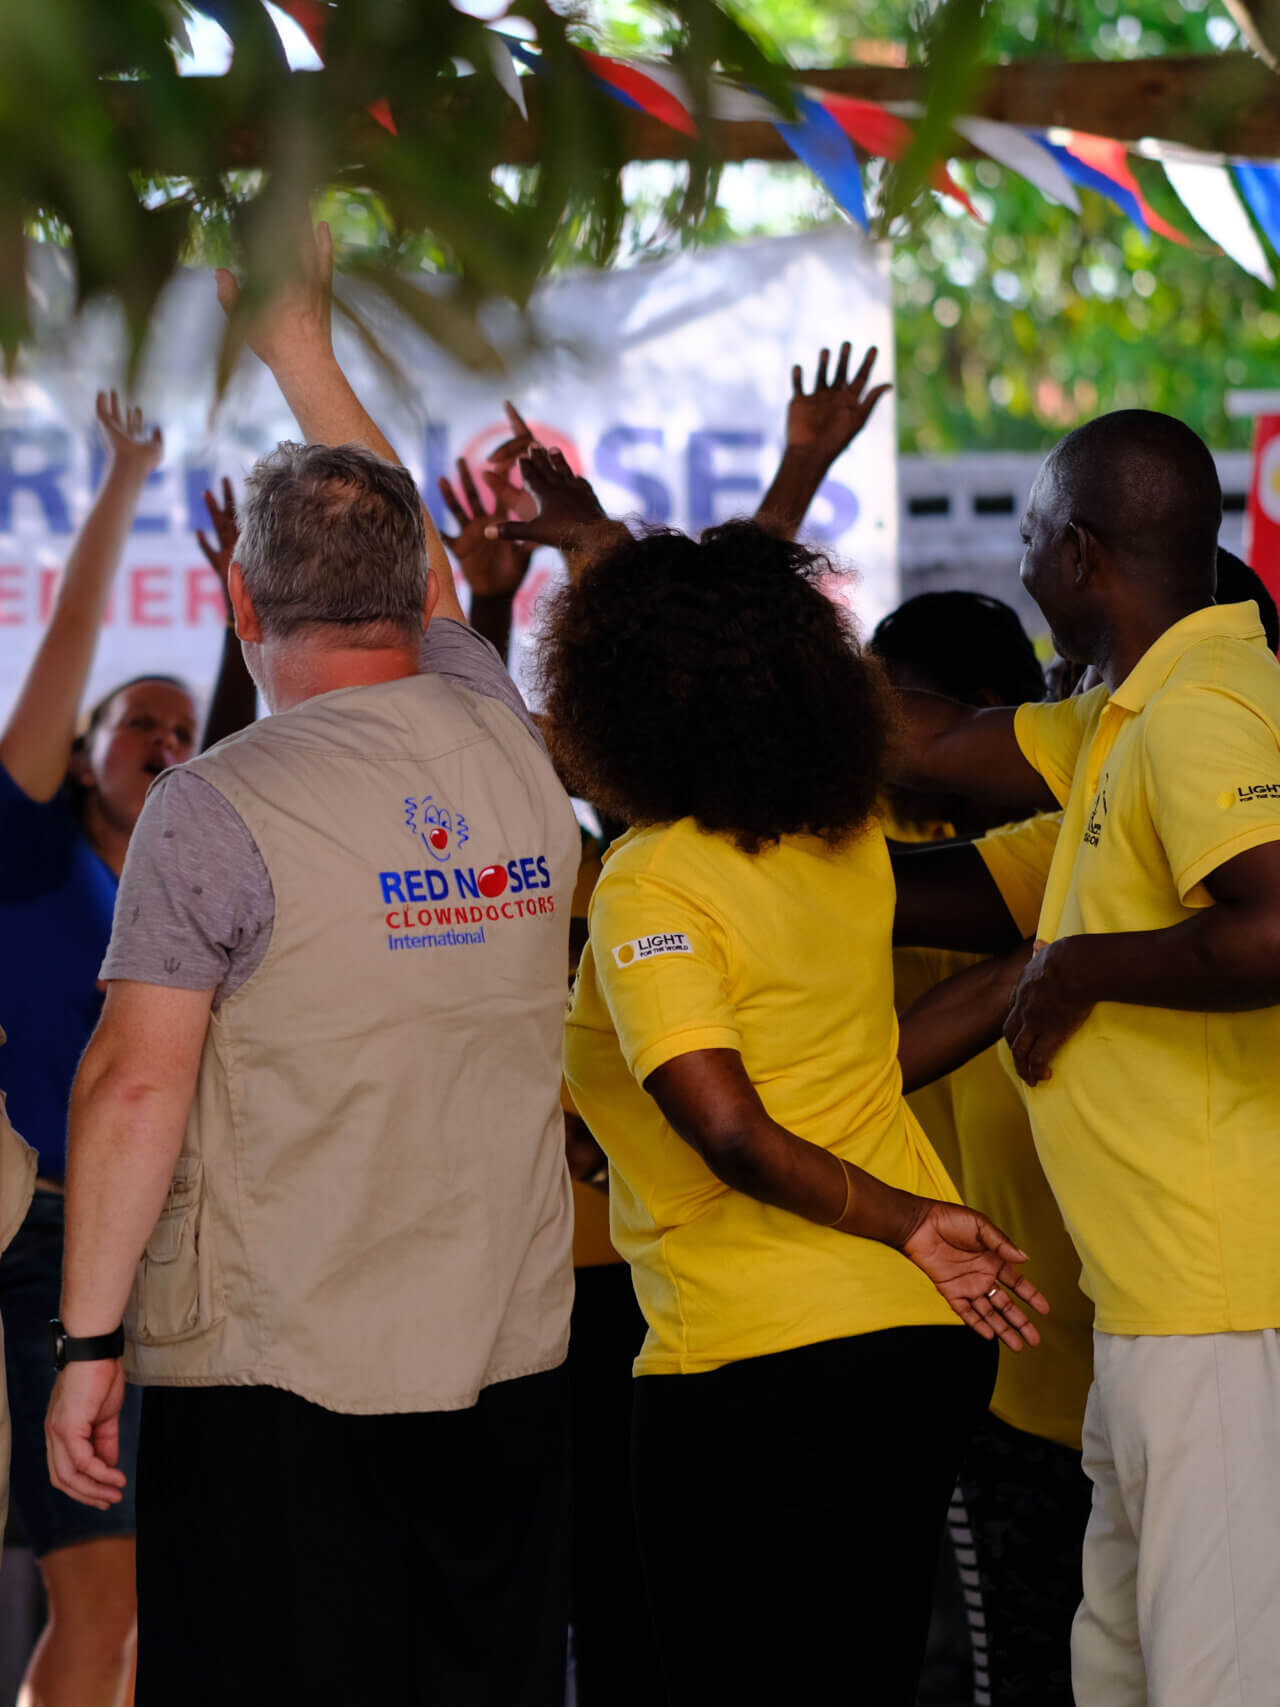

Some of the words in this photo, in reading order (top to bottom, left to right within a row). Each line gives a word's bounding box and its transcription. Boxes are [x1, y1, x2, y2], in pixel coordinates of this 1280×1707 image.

[378, 869, 449, 904] RED
[453, 855, 552, 899] NOSES
[385, 895, 555, 929] CLOWNDOCTORS
[387, 926, 486, 951] International
[638, 934, 685, 950] LIGHT
